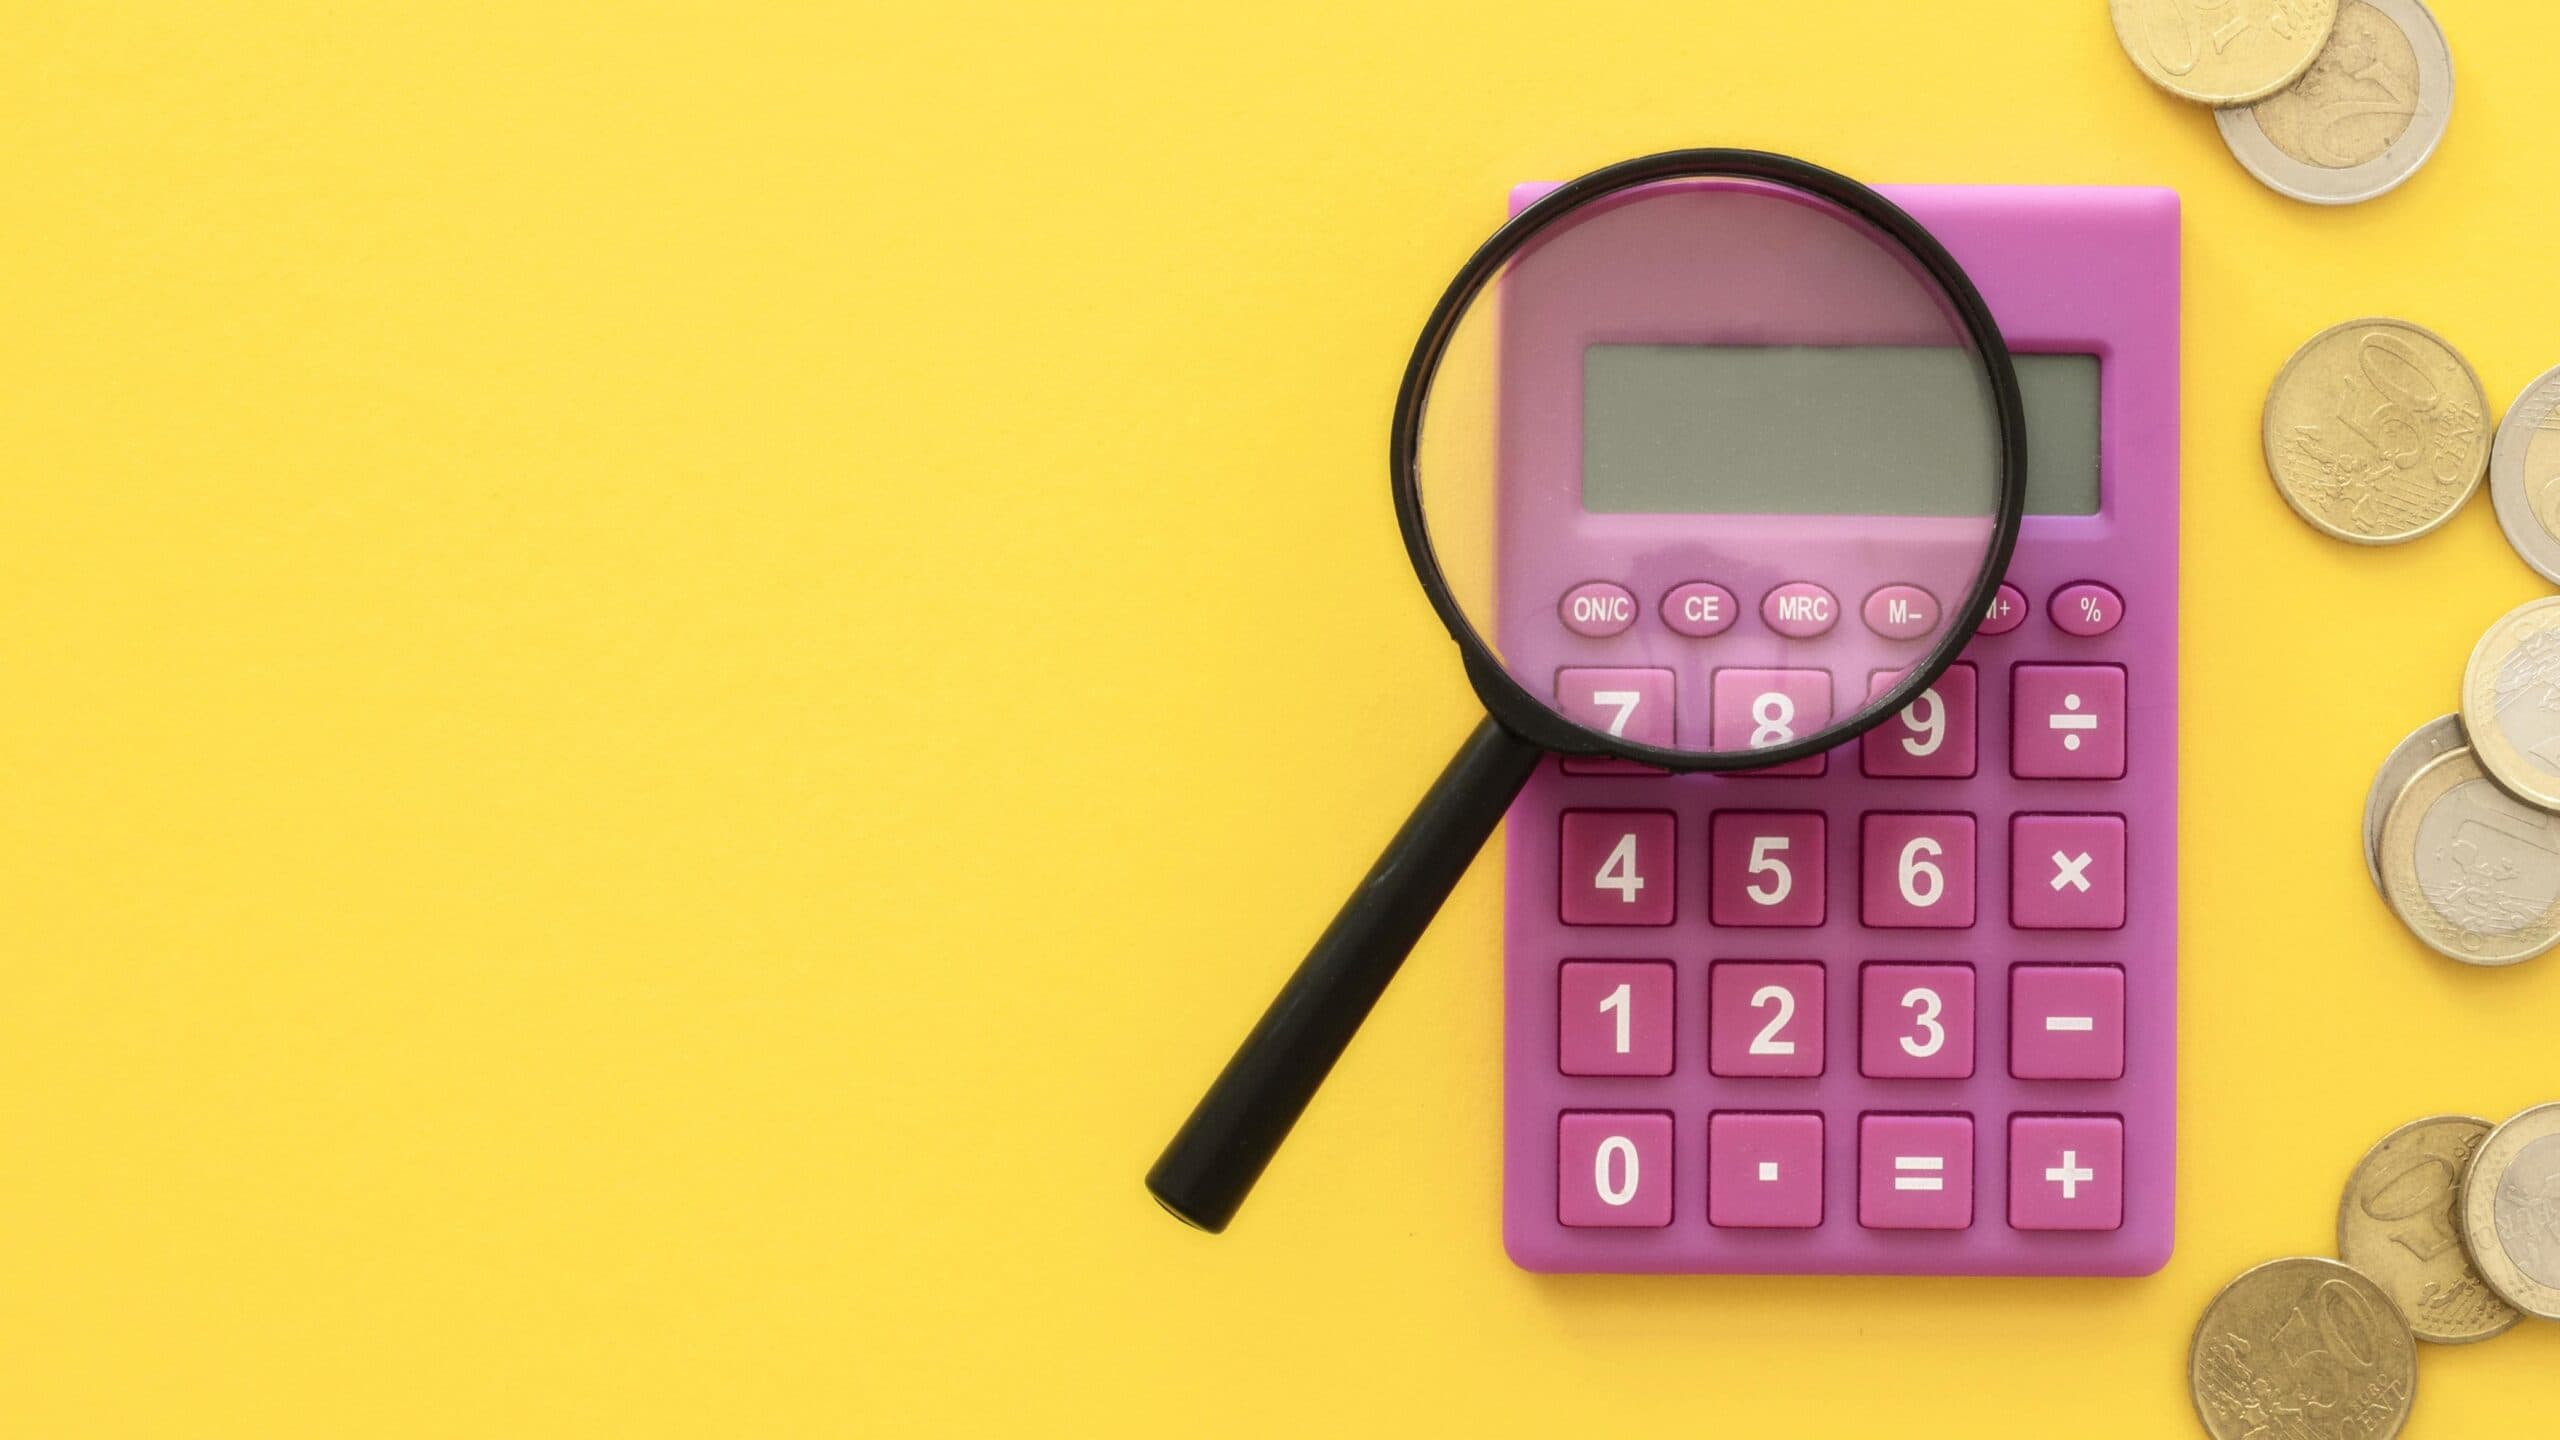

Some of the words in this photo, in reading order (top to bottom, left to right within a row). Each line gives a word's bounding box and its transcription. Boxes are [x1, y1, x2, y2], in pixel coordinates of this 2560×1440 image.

[2431, 400, 2481, 486] CENT
[1573, 596, 1629, 622] ON/C
[1684, 595, 1719, 621] CE
[1779, 596, 1828, 621] MRC
[1889, 599, 1922, 624] M-
[2080, 597, 2102, 622] %
[1593, 691, 1640, 738] 7
[1751, 691, 1795, 749] 8
[1901, 688, 1946, 757] 9
[1594, 833, 1644, 903] 4
[1746, 836, 1792, 906] 5
[1898, 836, 1944, 907] 6
[1599, 983, 1631, 1054] 1
[1748, 985, 1795, 1055] 2
[1899, 987, 1945, 1058] 3
[1594, 1135, 1640, 1206] 0
